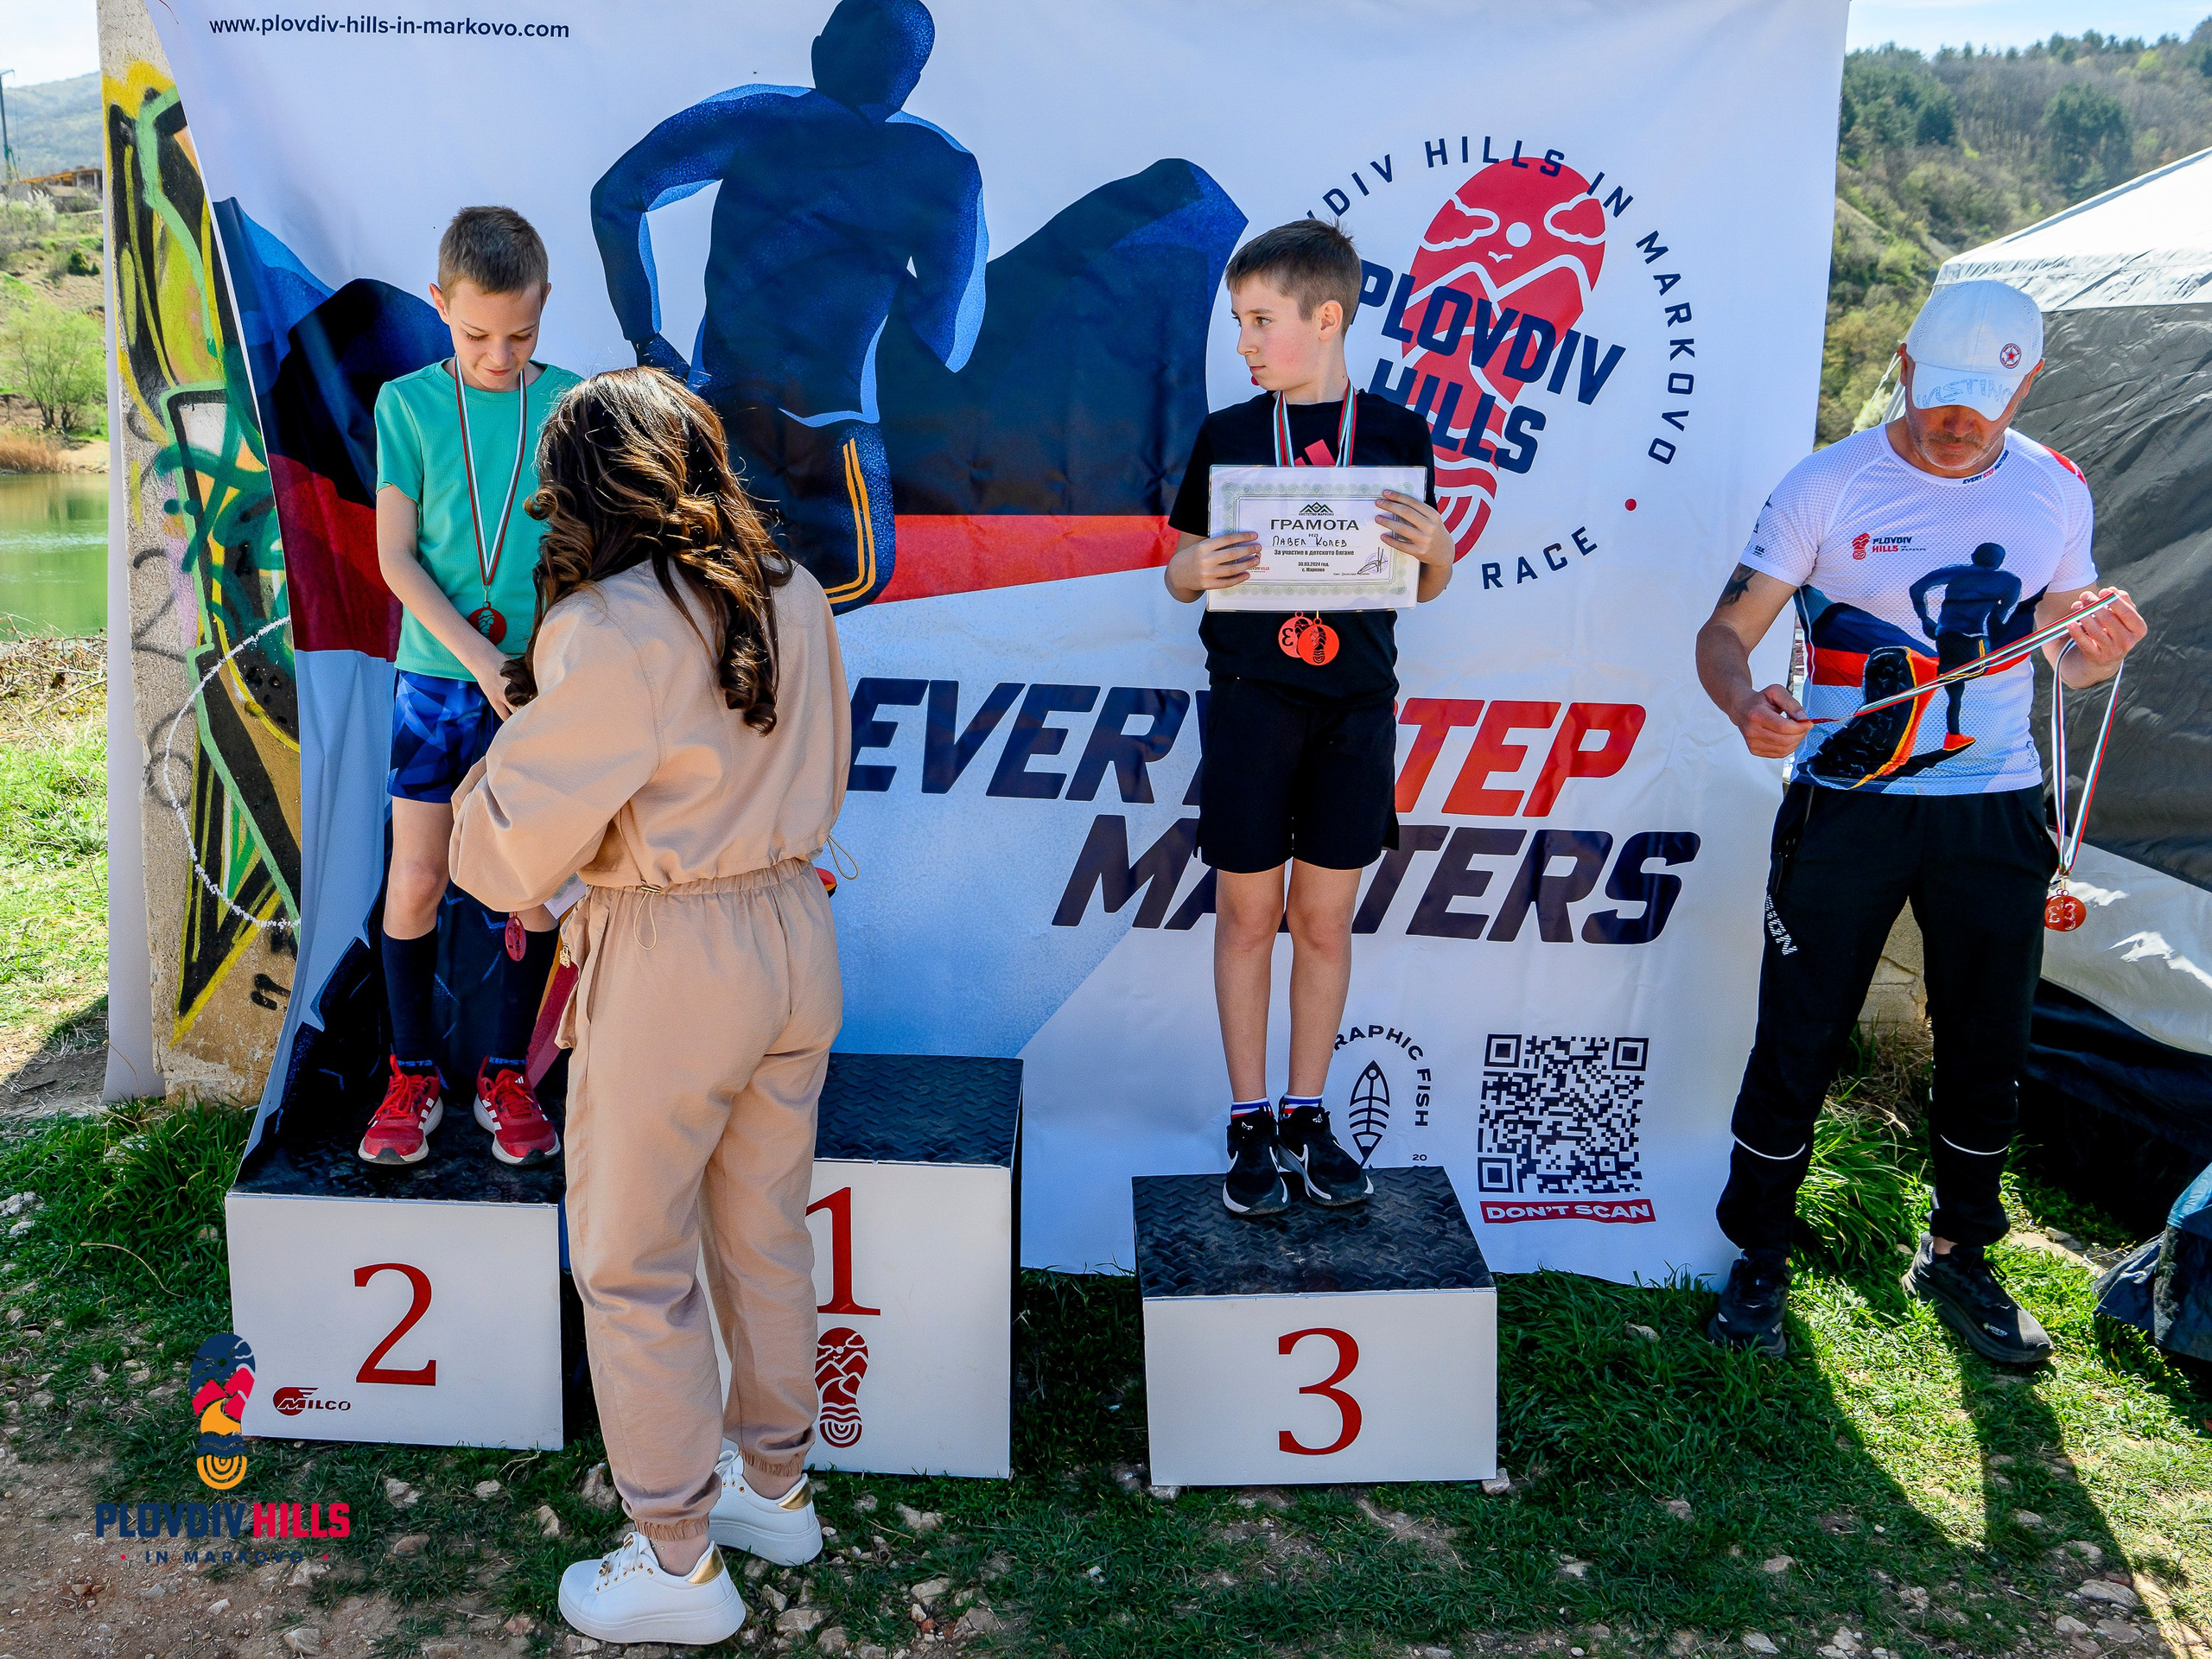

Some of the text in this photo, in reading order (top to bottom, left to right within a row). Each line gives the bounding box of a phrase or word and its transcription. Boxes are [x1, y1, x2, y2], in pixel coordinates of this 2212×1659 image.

[209, 14, 570, 39] www.plovdiv-hills-in-markovo.com
[1351, 258, 1626, 406] PLOVDIV
[1424, 136, 1566, 177] HILLS
[1586, 171, 1634, 219] IN
[1635, 231, 1696, 465] MARKOVO
[1270, 519, 1359, 531] ГРАМОТА
[1481, 525, 1598, 590] RACE
[1394, 697, 1647, 817] TEP
[489, 1057, 527, 1065] KIPST
[1331, 1024, 1432, 1127] RAPHIC FISH
[805, 1187, 880, 1317] 1
[1486, 1205, 1650, 1219] DON'T SCAN
[353, 1262, 436, 1386] 2
[277, 1399, 351, 1411] MILCO
[1278, 1327, 1363, 1456] 3
